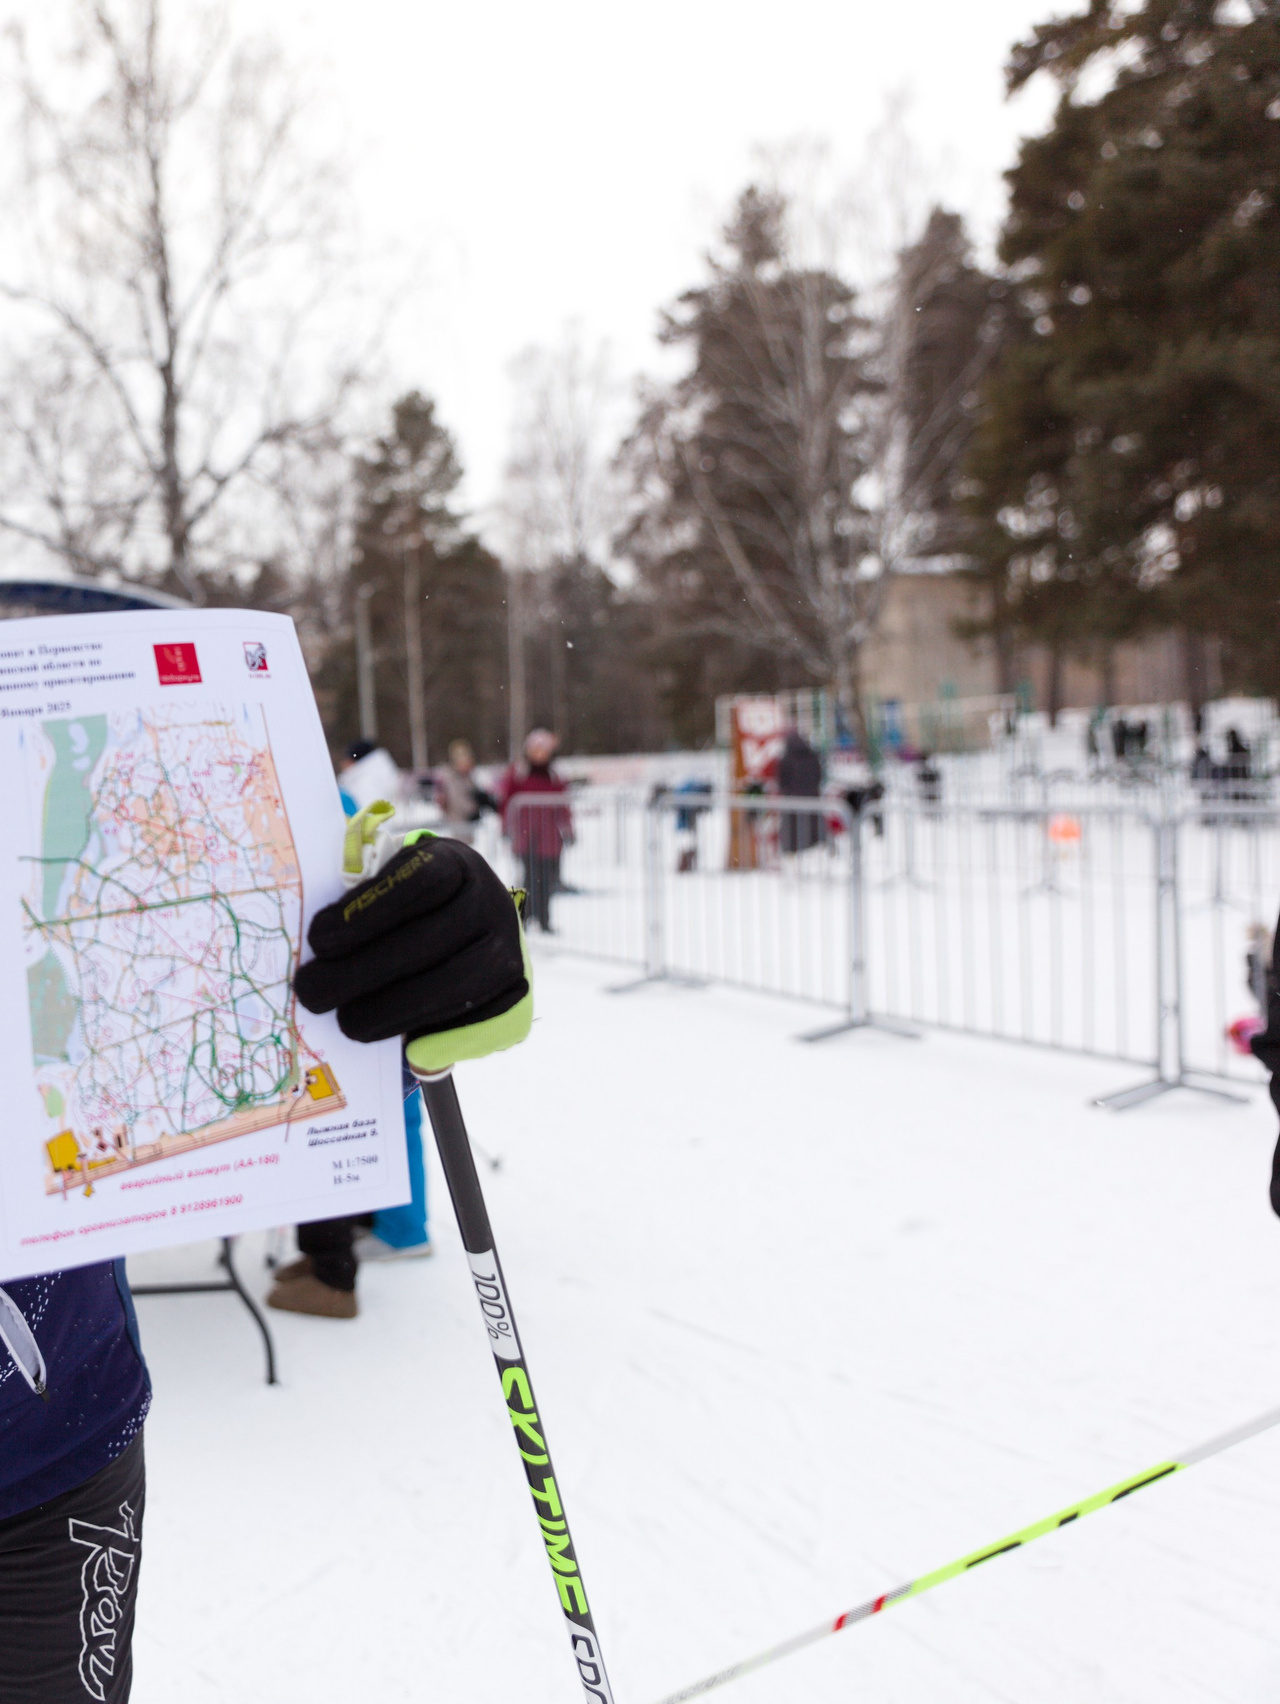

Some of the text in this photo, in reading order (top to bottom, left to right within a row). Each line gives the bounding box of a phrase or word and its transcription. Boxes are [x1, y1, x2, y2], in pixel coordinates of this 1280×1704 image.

[343, 857, 426, 922] FISCHER
[187, 1161, 231, 1179] азимут
[472, 1273, 512, 1340] 100%
[528, 1476, 589, 1615] TIME
